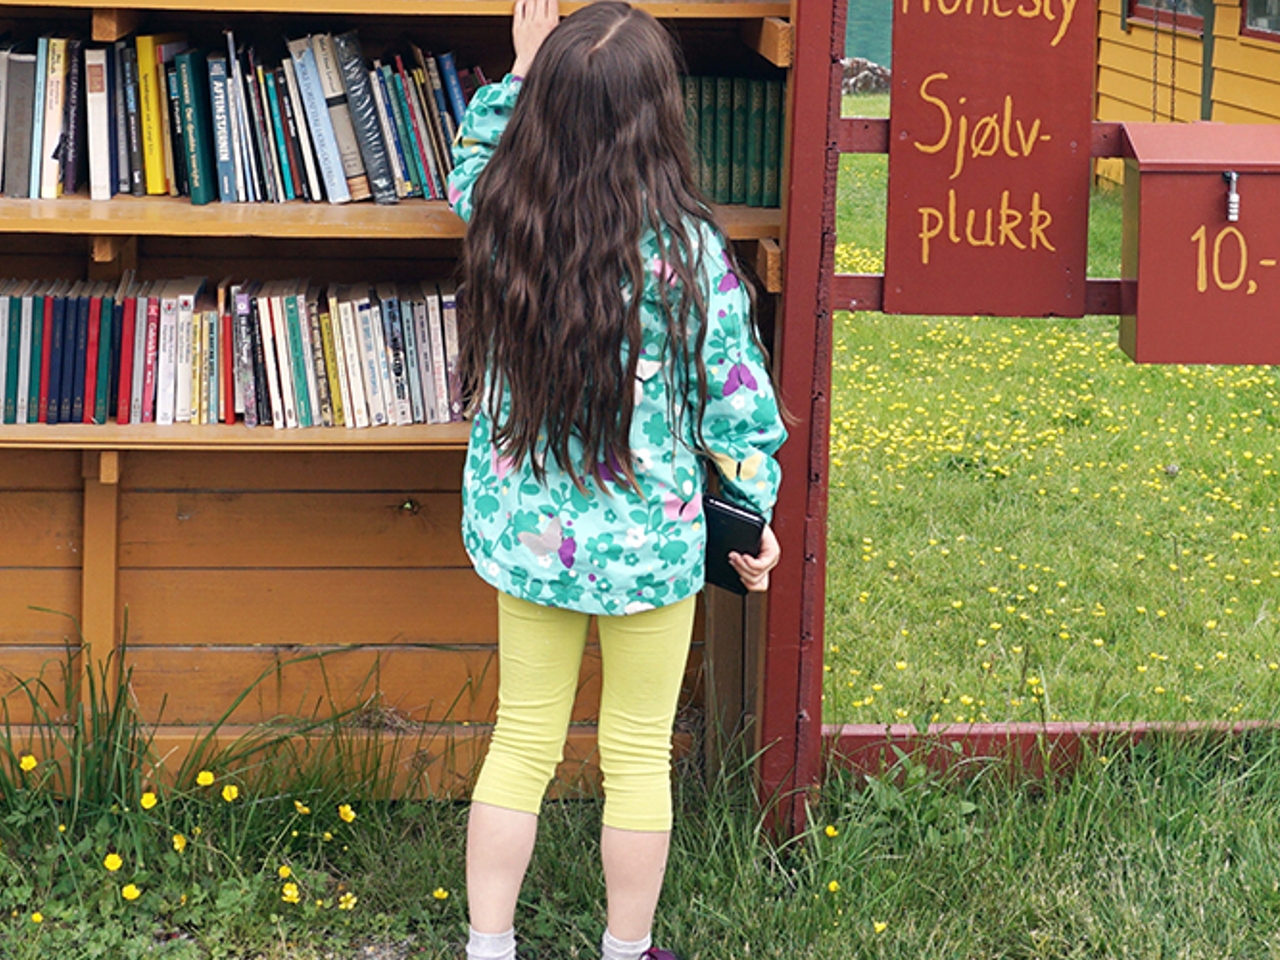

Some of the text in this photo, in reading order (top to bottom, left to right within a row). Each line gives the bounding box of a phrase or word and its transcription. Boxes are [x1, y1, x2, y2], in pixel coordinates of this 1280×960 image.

[914, 72, 1051, 179] Sjølv-
[917, 189, 1055, 264] plukk
[1190, 224, 1277, 295] 10,-
